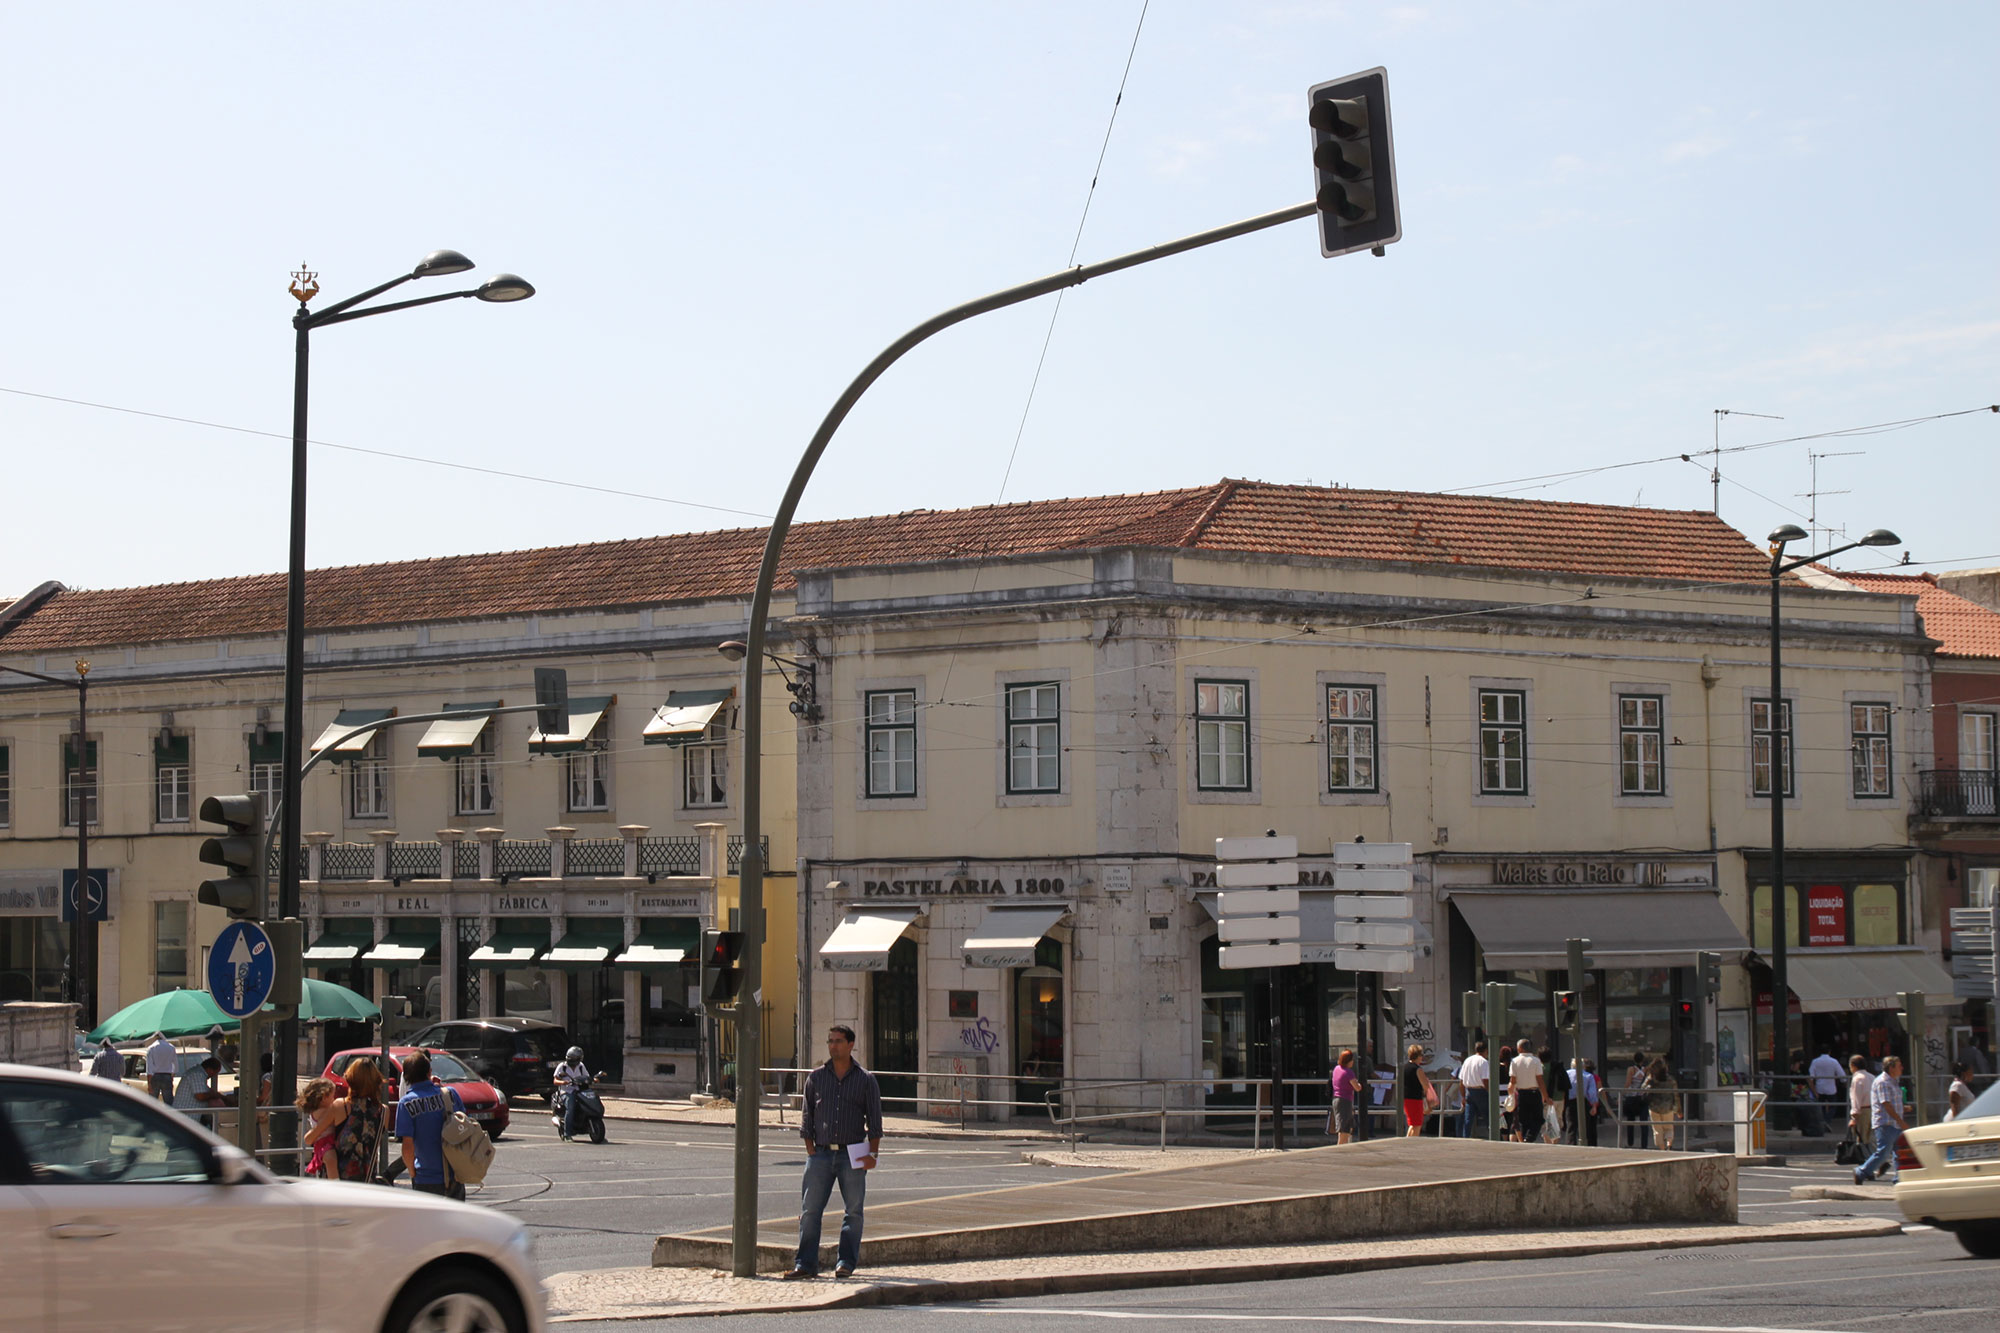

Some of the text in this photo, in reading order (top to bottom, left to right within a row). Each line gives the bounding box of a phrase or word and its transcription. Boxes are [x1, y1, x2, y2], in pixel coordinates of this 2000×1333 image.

[1496, 863, 1626, 884] Malas do Rato
[863, 877, 1065, 896] PASTELARIA 1800
[398, 898, 430, 910] REAL
[499, 893, 549, 910] FÁBRICA
[641, 898, 698, 907] RESTAURANTE
[1809, 896, 1844, 910] LIQUIDAÇÃO
[1817, 915, 1836, 925] TOTAL
[1850, 998, 1889, 1009] SECRET
